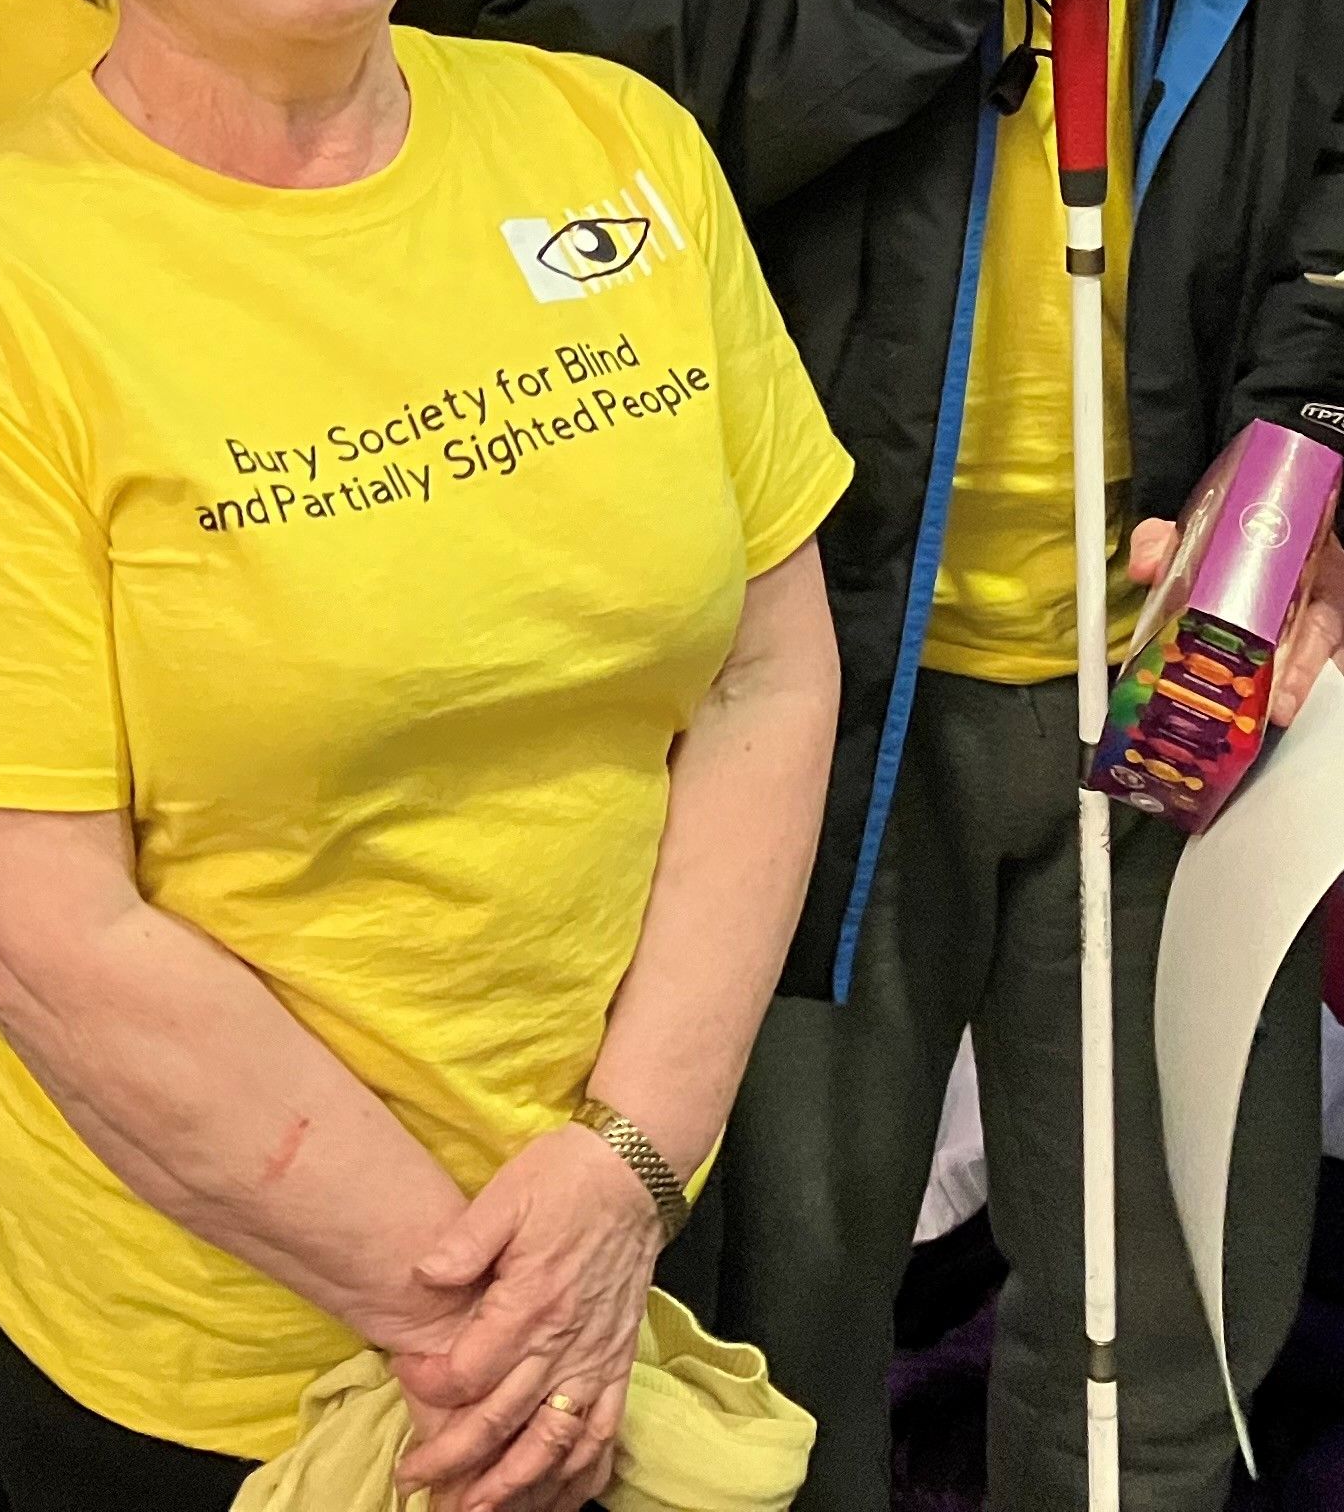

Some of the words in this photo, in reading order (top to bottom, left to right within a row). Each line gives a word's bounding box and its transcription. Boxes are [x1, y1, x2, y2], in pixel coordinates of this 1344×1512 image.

[195, 485, 271, 533] and
[271, 463, 431, 524] Partially
[442, 395, 599, 481] Sighted
[592, 362, 711, 428] People
[224, 437, 317, 482] Bury
[327, 385, 487, 463] Society
[495, 368, 553, 405] for
[554, 333, 641, 385] Blind
